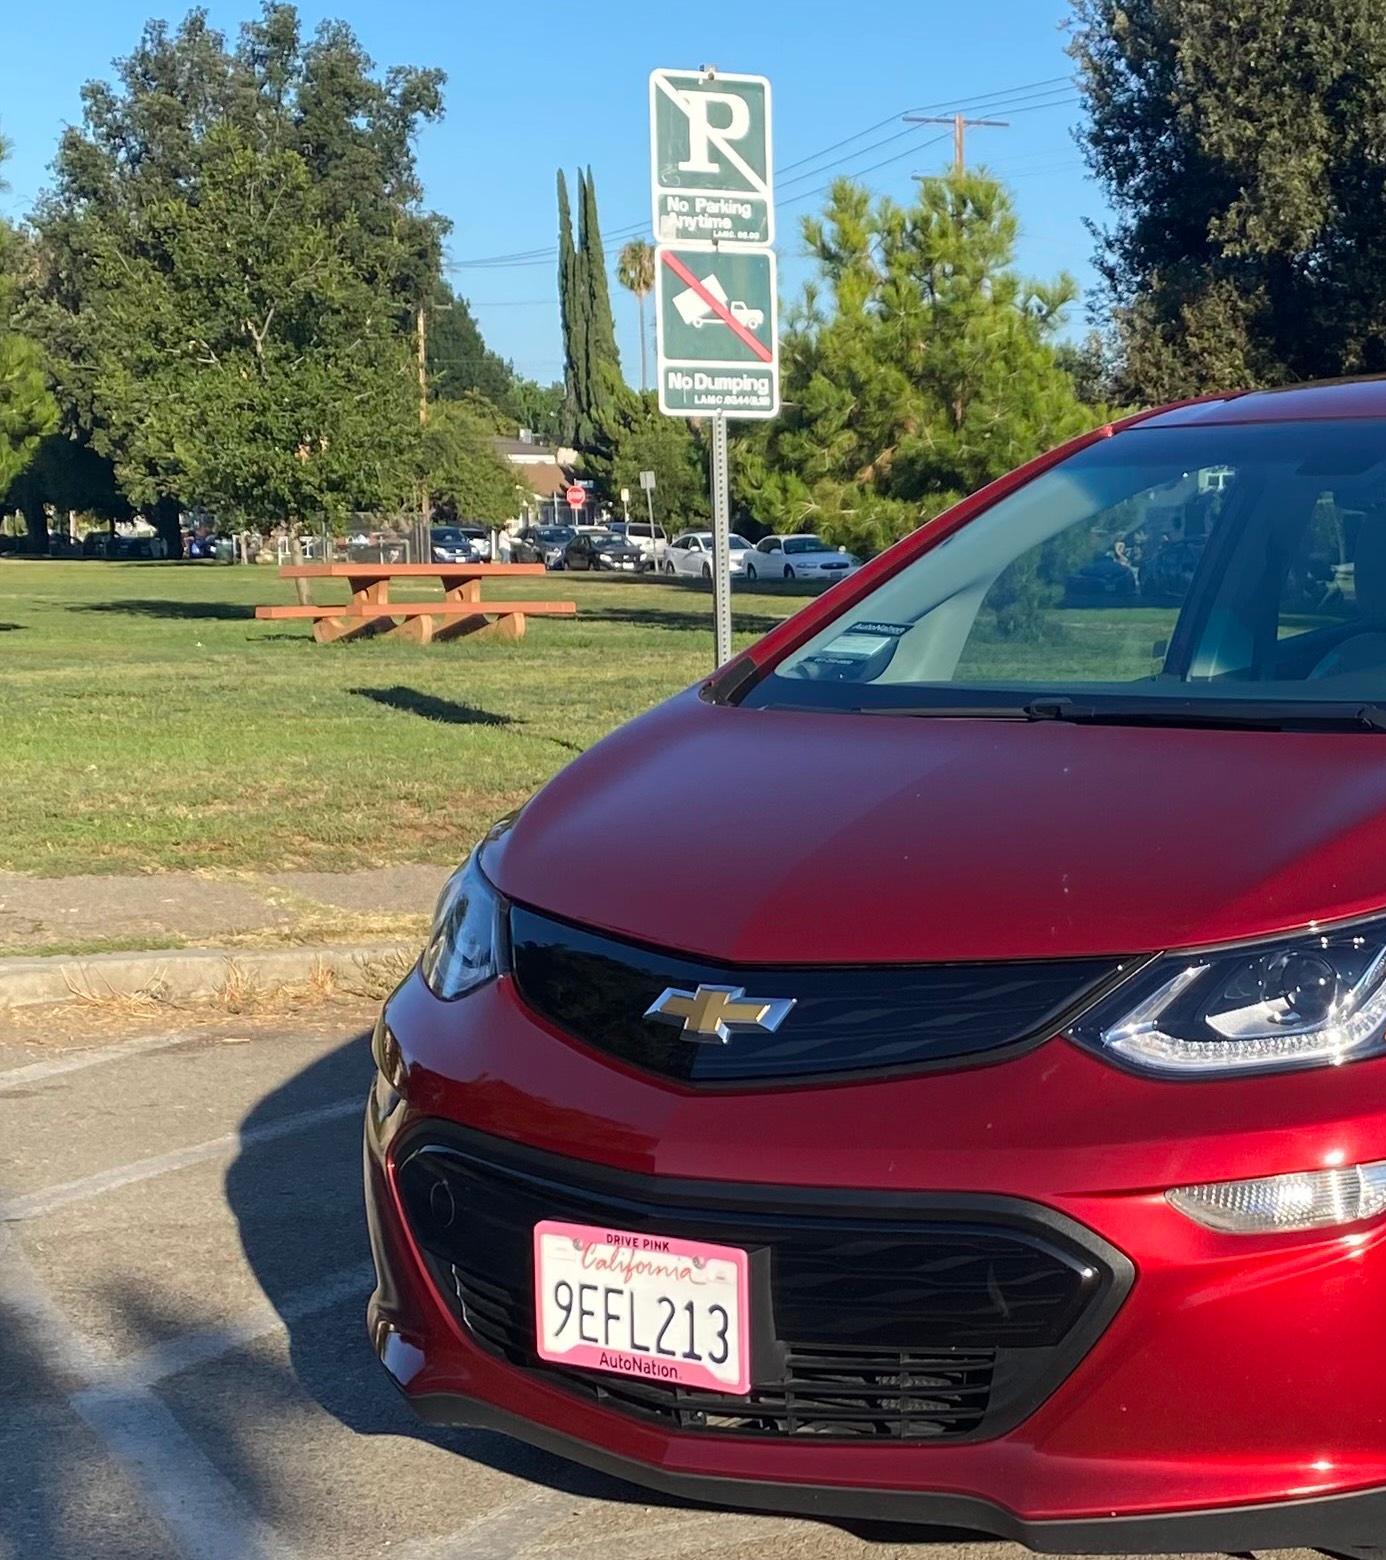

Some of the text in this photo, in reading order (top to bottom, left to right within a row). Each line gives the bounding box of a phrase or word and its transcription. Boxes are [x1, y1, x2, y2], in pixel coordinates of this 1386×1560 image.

[667, 196, 752, 219] No Parking
[668, 372, 769, 395] No Dumping
[606, 1234, 670, 1252] DRIVE PINK
[581, 1242, 707, 1284] California
[554, 1279, 730, 1364] 9EFL213
